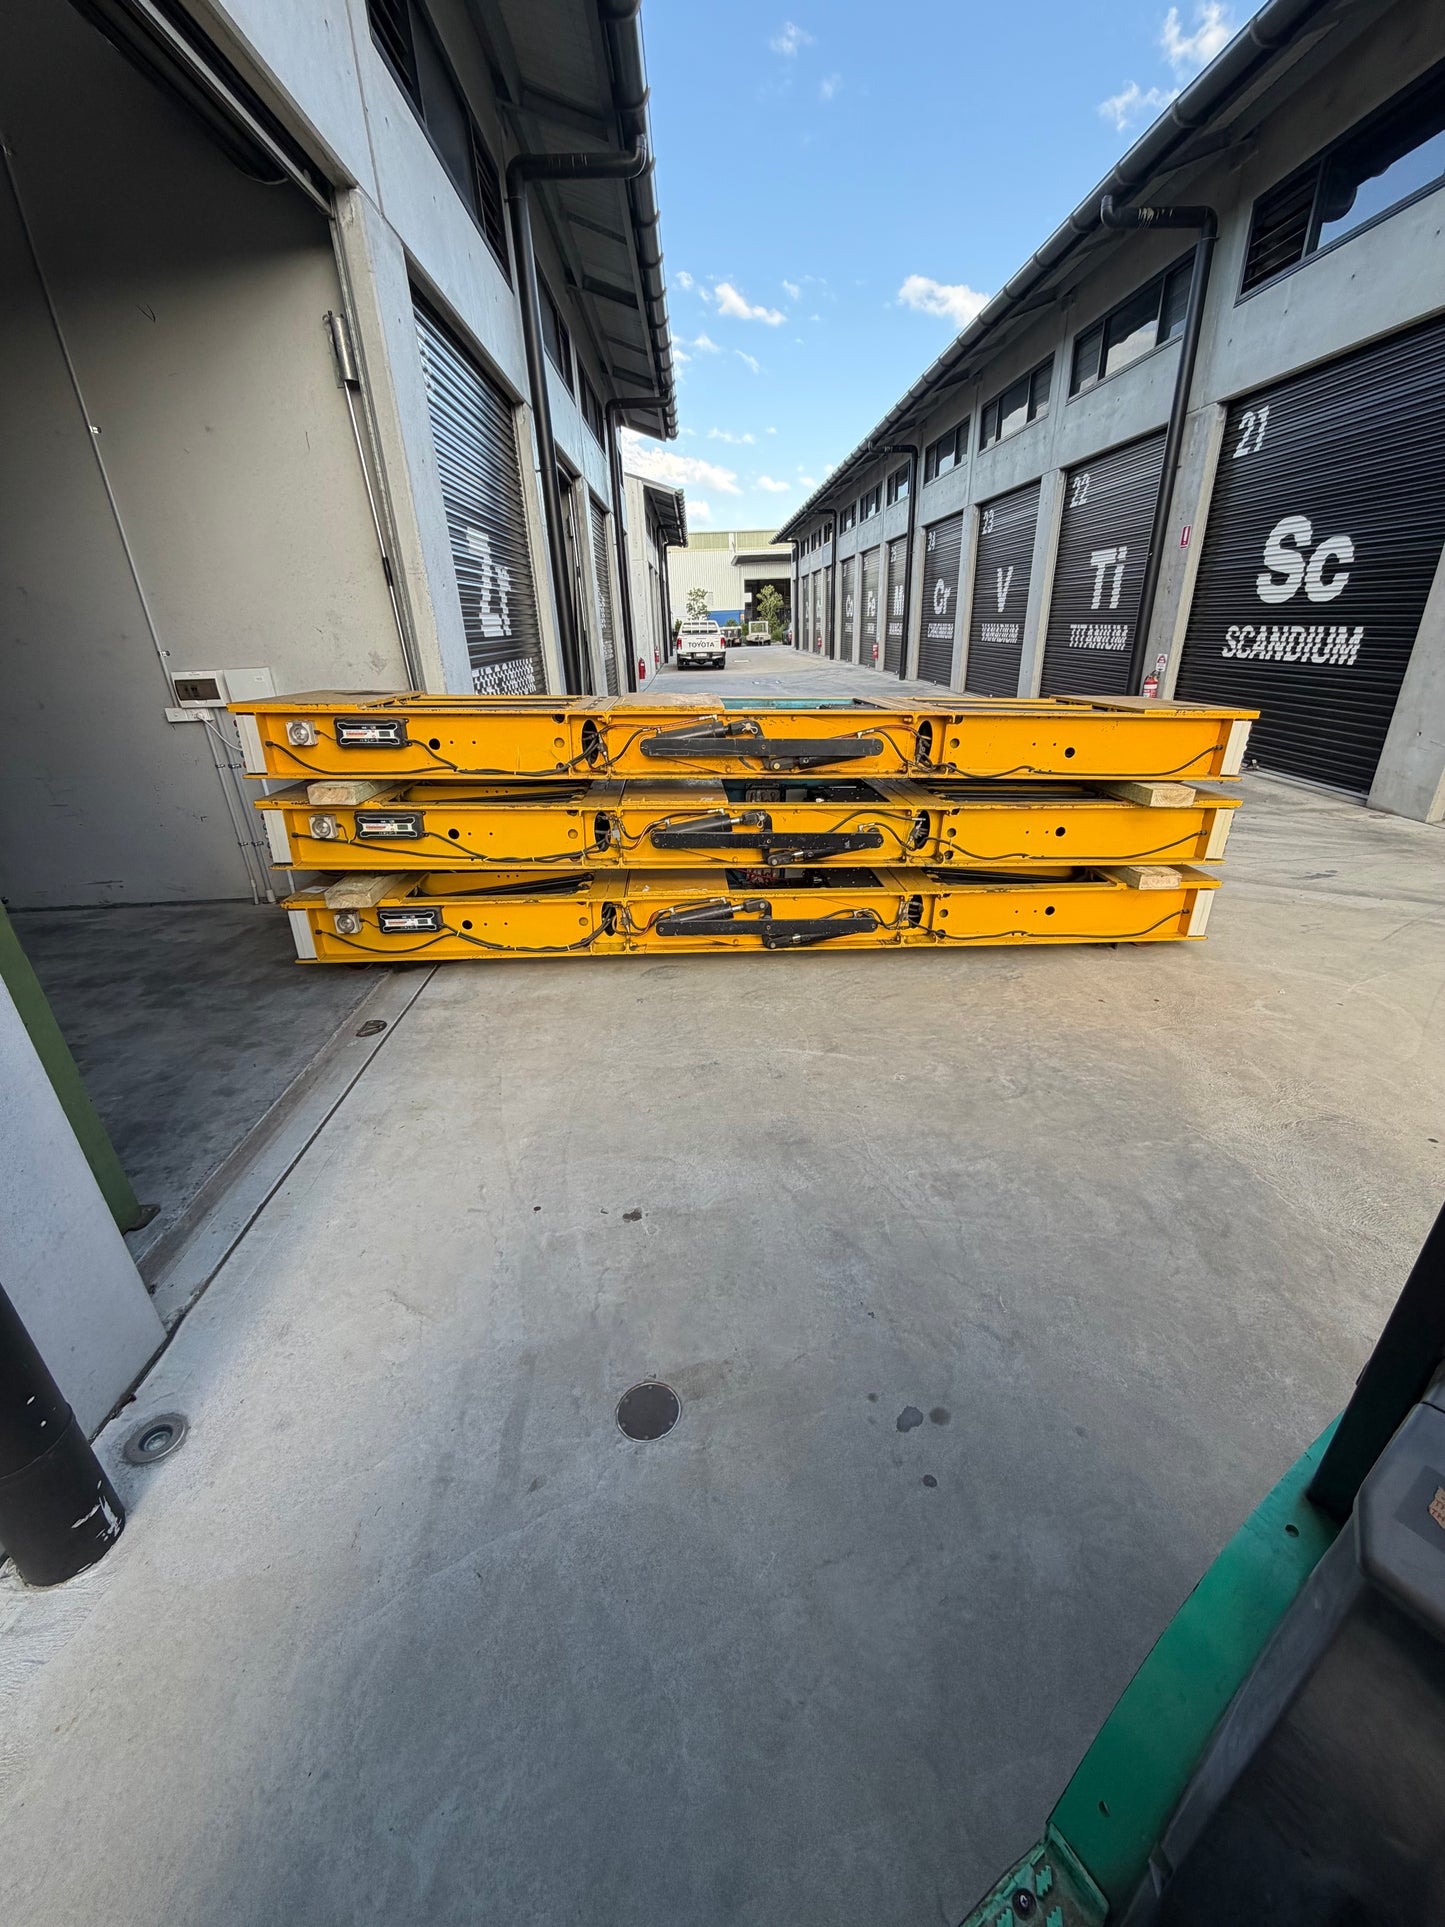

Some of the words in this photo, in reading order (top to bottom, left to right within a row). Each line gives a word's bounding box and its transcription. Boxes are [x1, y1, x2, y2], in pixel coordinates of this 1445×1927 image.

[1233, 405, 1269, 459] 21
[1069, 473, 1091, 509] 22
[981, 509, 995, 535] 23
[1090, 546, 1128, 609] Ti
[1255, 515, 1355, 604] Sc
[933, 578, 952, 615] Cr
[996, 566, 1014, 613] V
[688, 641, 715, 649] TOYOTA
[1069, 624, 1129, 651] TITANIUM
[1221, 625, 1364, 666] SCANDIUM
